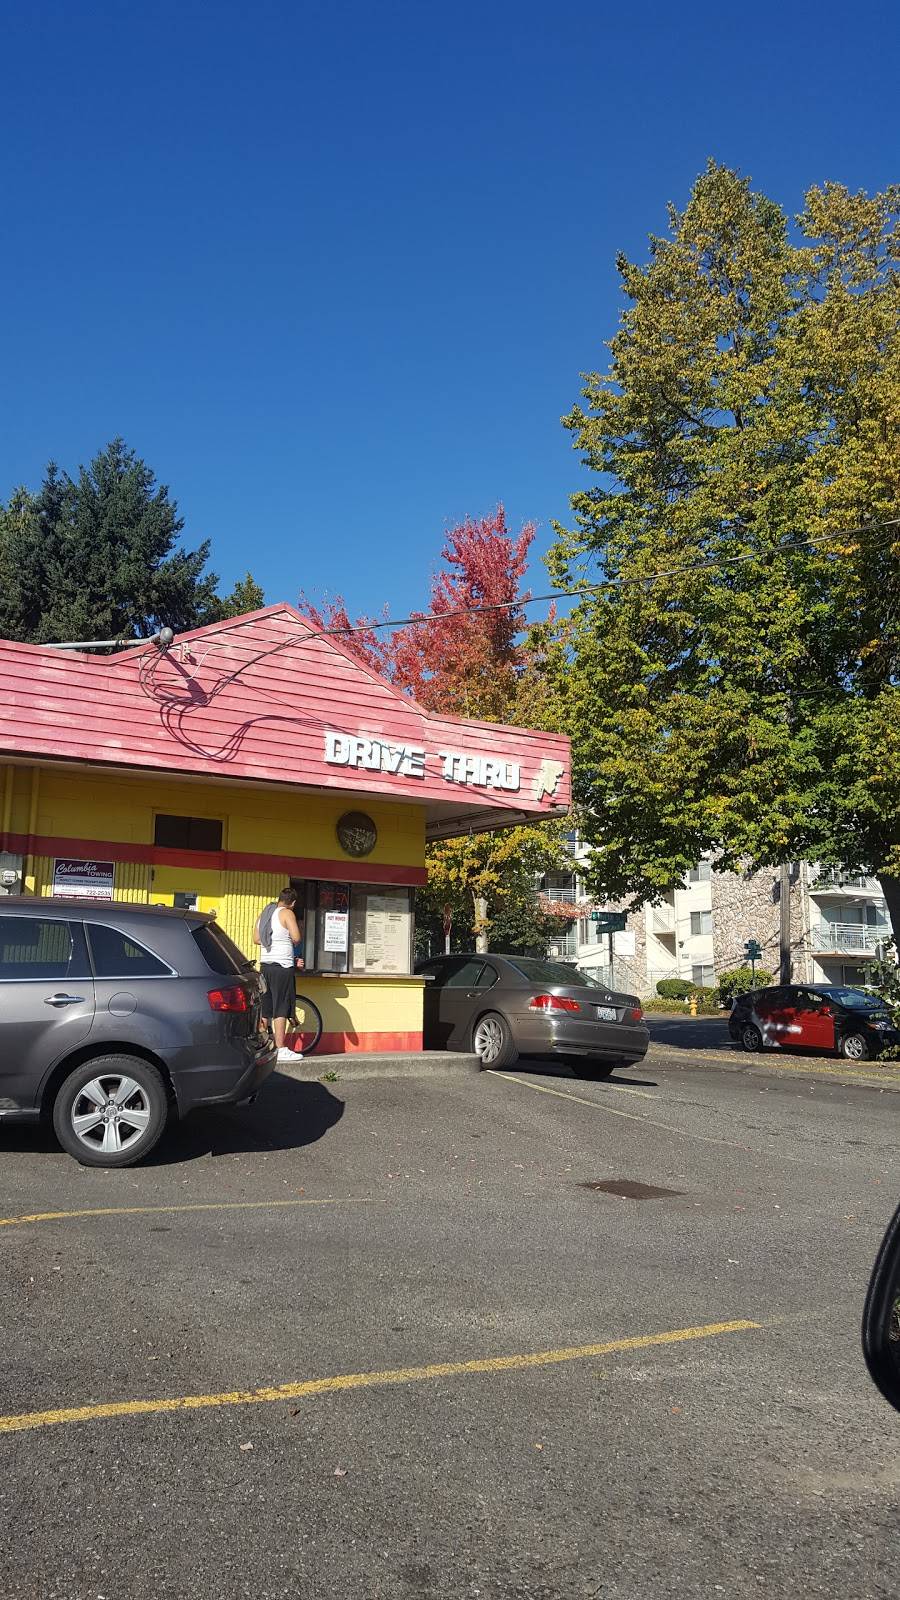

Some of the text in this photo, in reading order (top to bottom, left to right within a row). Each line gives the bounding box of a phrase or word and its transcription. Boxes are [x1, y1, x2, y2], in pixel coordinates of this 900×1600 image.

[323, 731, 521, 793] DRIVE THRU
[56, 862, 97, 875] Columbia
